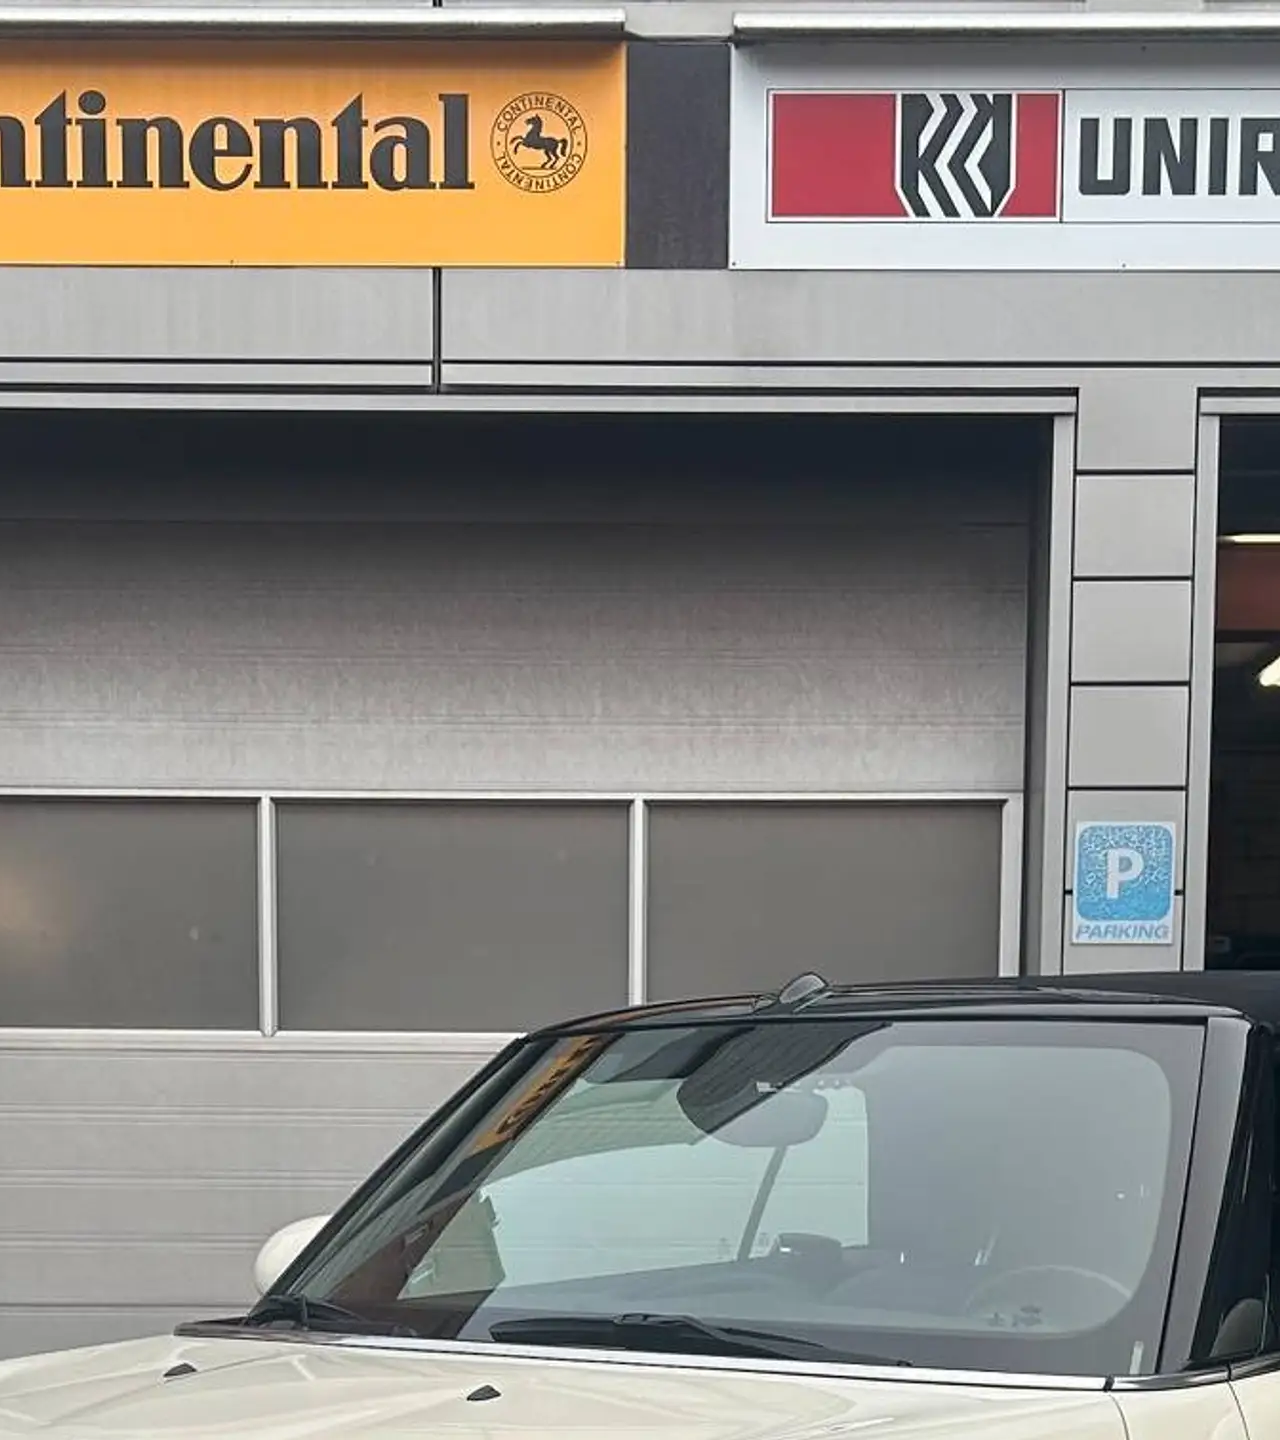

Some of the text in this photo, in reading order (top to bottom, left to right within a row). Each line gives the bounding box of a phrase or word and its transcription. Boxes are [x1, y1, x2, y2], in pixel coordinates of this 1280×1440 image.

[496, 95, 583, 135] CONTINENTAL
[1106, 848, 1145, 900] P
[1075, 924, 1170, 940] PARKING
